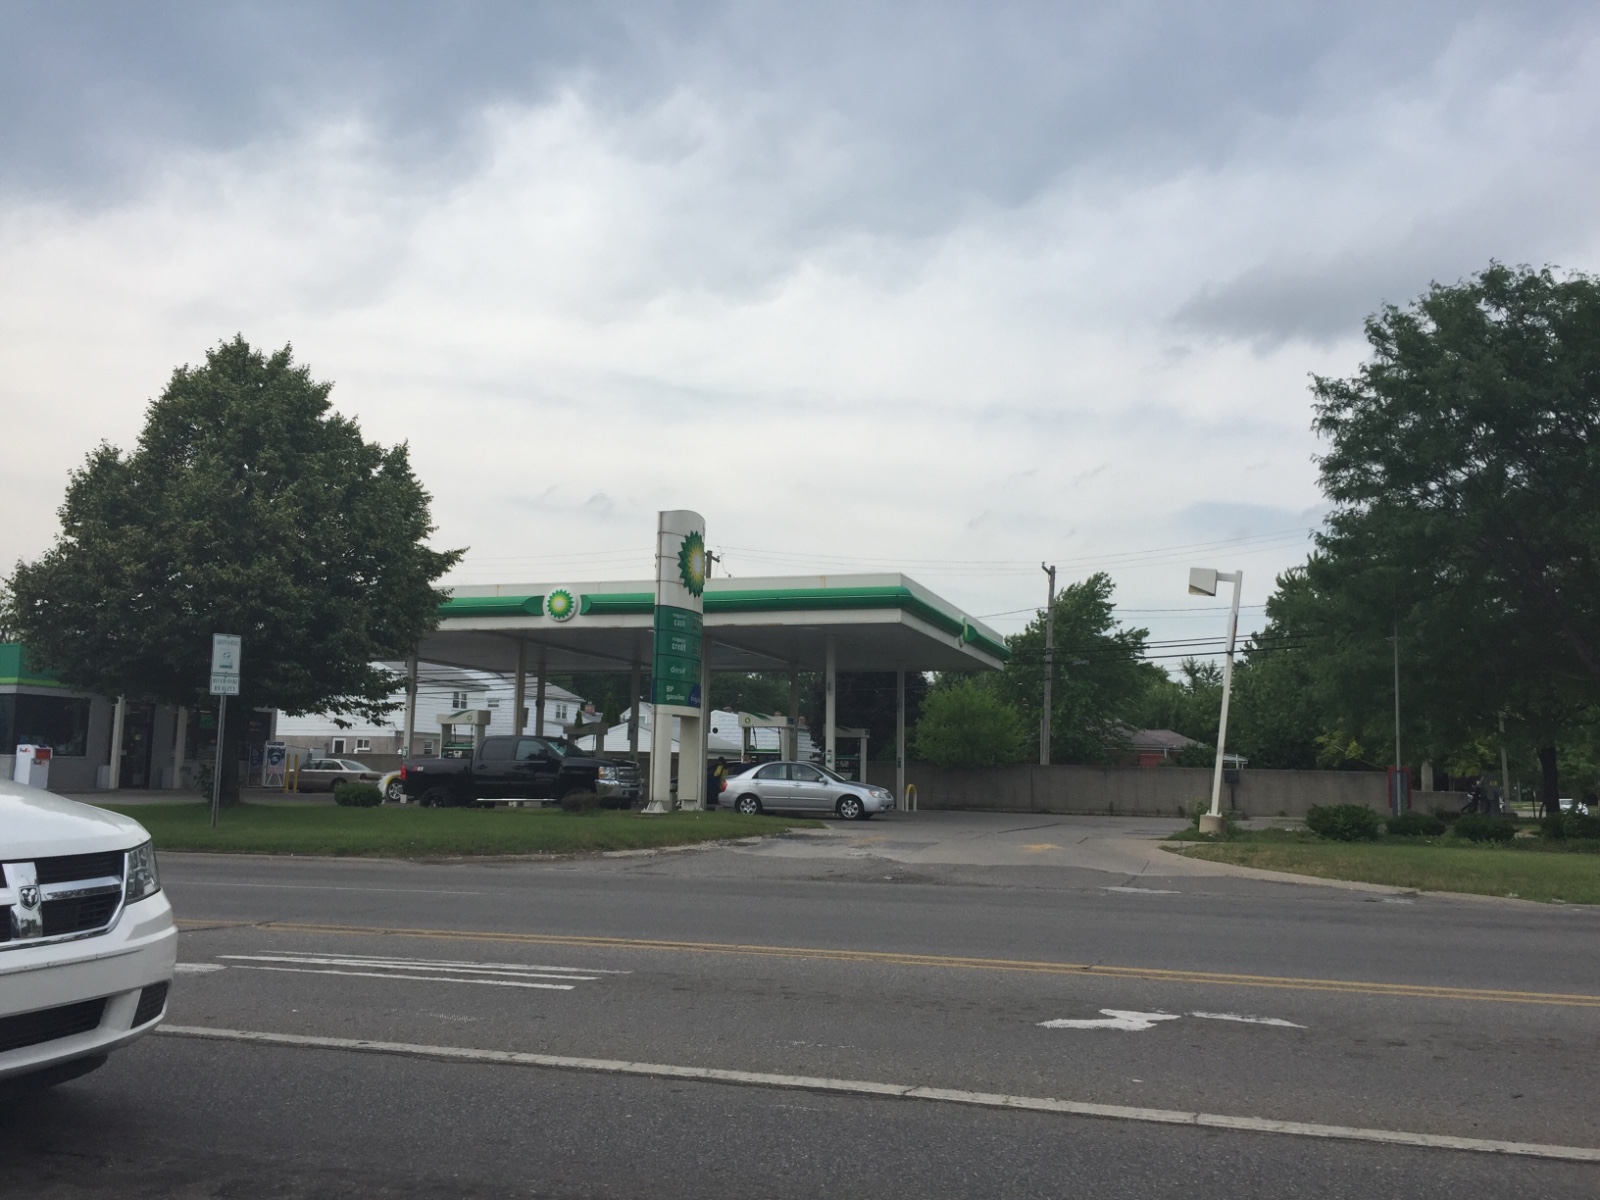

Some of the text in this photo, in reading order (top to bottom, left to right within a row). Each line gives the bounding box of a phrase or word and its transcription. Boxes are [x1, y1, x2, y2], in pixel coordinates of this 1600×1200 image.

[673, 619, 686, 627] cash
[672, 643, 686, 651] credit
[670, 665, 686, 675] diesel
